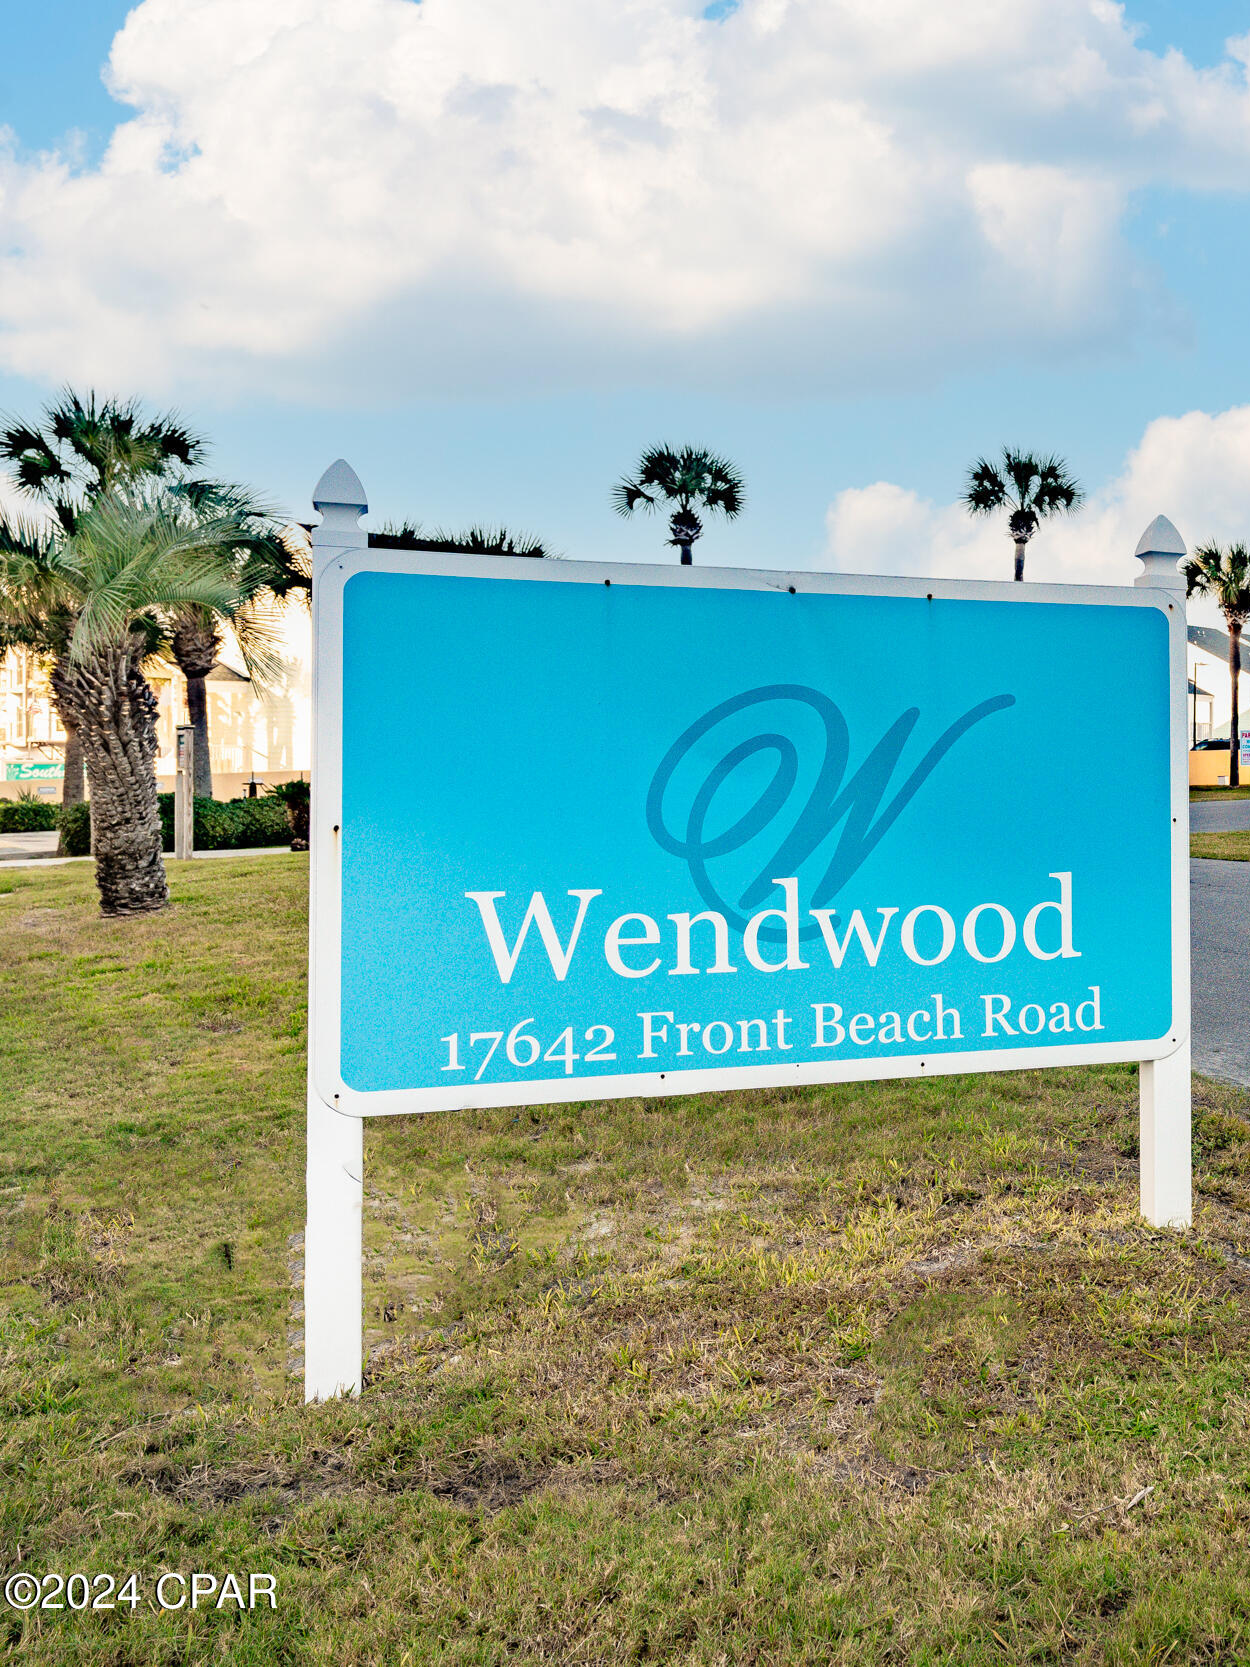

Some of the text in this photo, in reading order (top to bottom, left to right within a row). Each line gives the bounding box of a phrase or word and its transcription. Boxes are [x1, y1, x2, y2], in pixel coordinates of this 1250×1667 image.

[464, 872, 1082, 984] Wendwood
[439, 986, 1104, 1081] 17642 Front Beach Road
